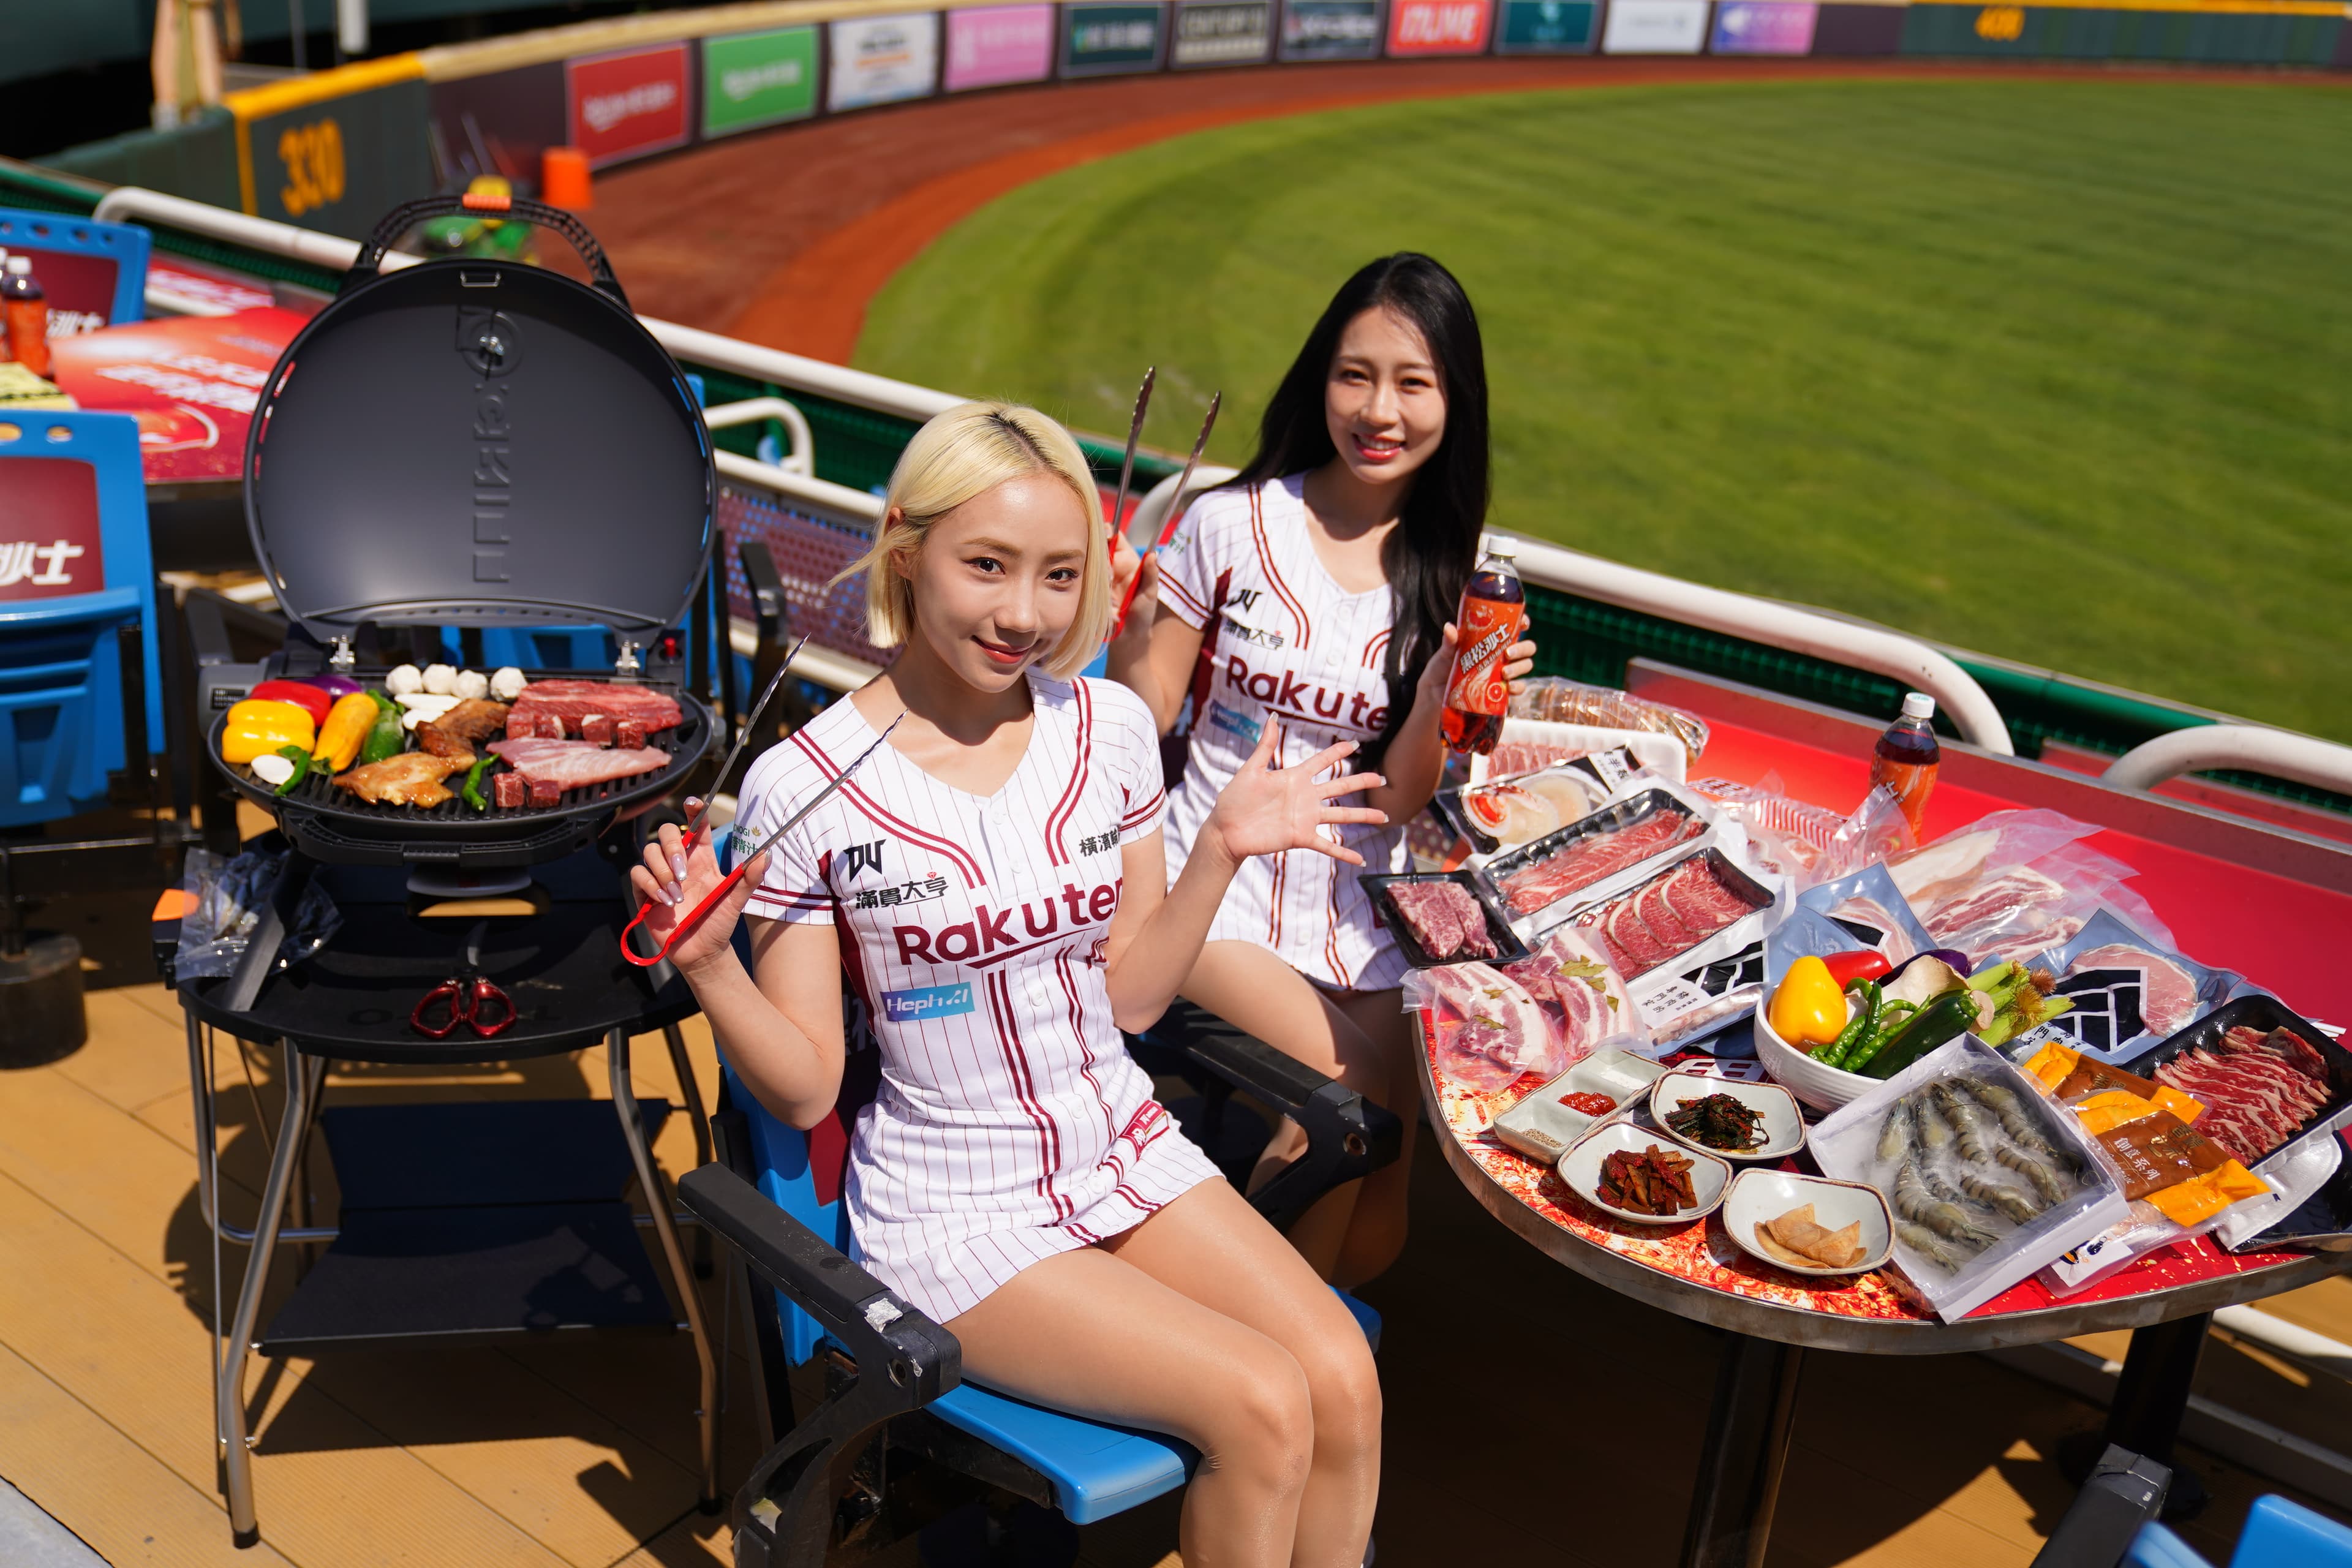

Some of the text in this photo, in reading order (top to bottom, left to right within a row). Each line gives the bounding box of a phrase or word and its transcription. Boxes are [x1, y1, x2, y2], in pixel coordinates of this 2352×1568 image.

[279, 118, 345, 217] 330
[1460, 623, 1510, 674] 黑松沙士
[856, 876, 948, 909] 滿貫大亨
[2113, 1137, 2161, 1180] 創意系列
